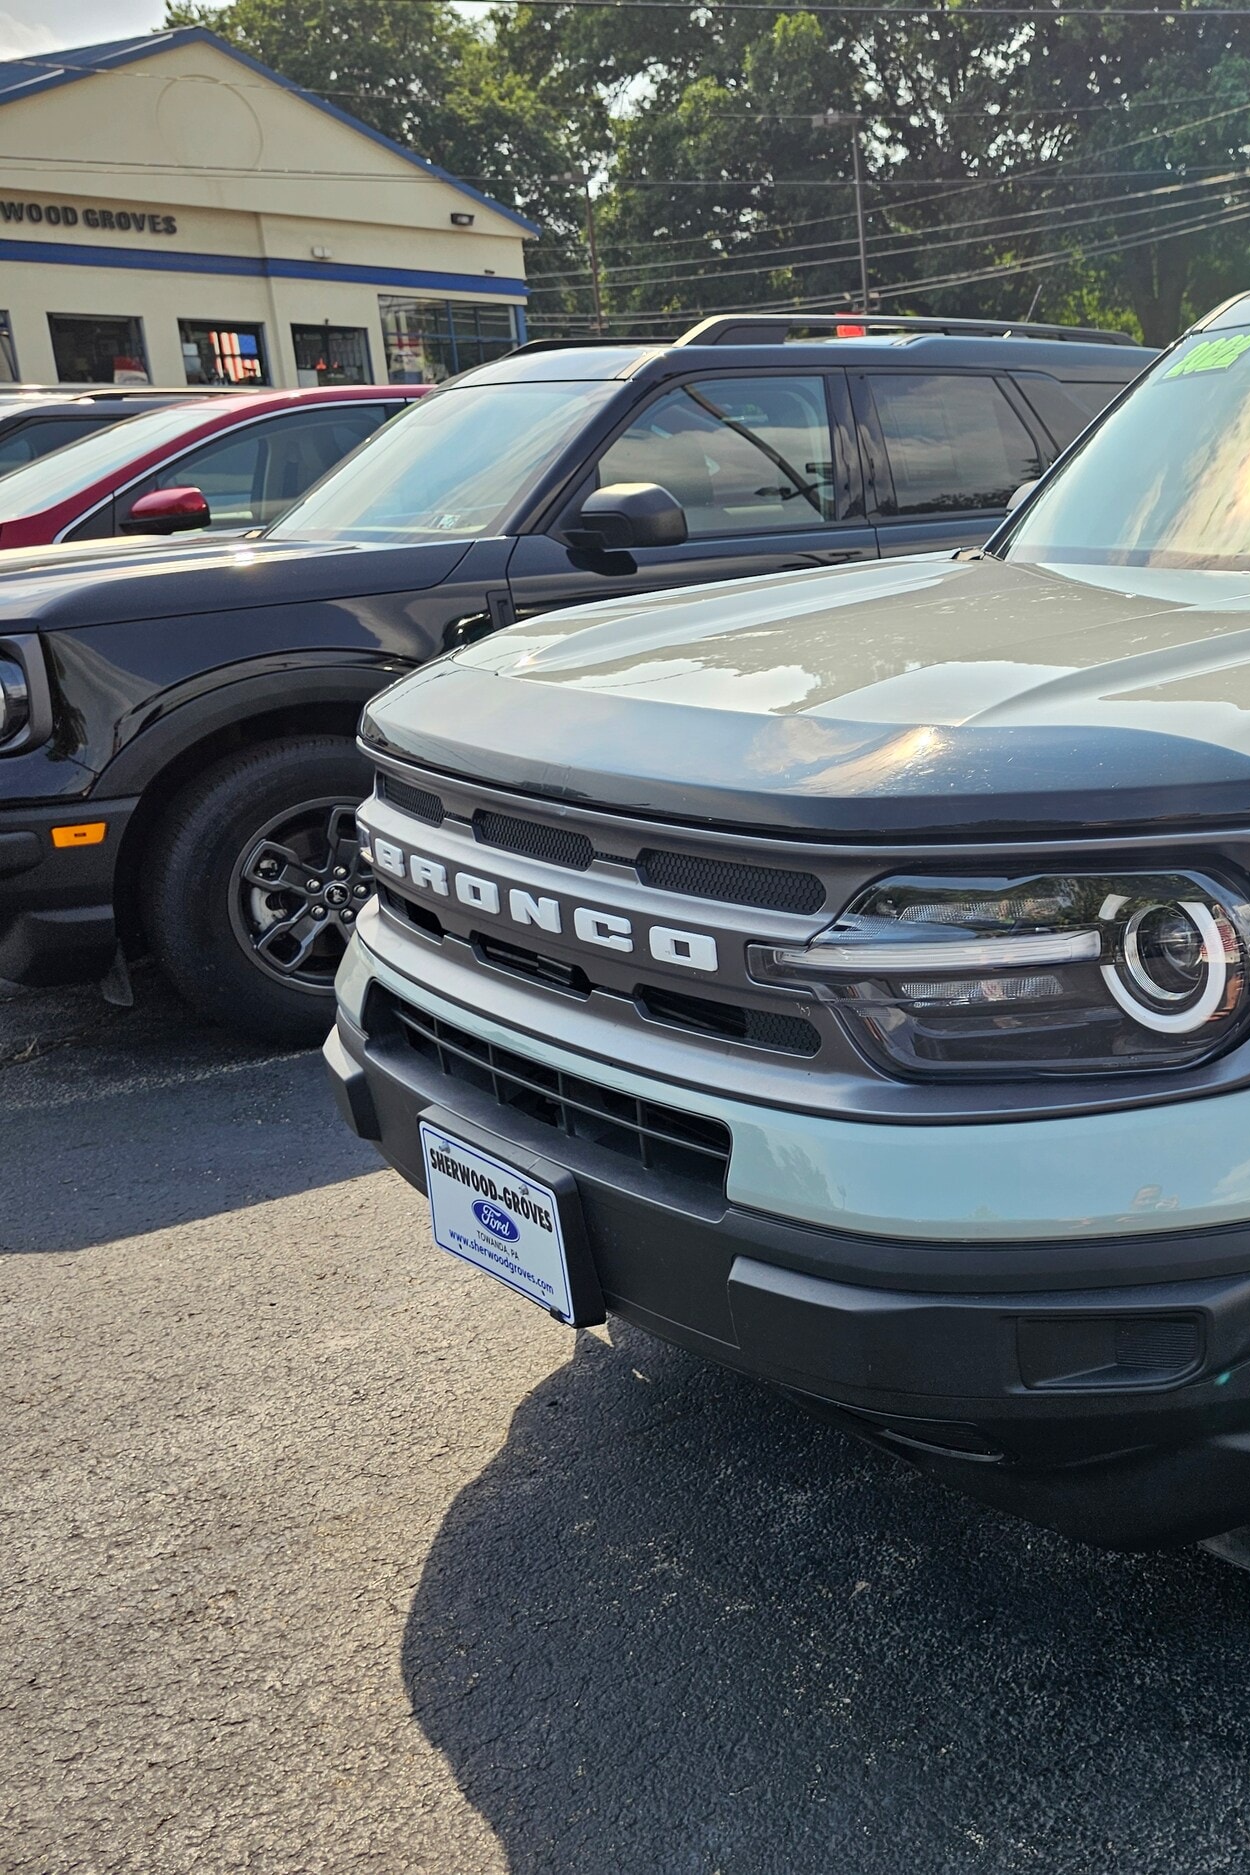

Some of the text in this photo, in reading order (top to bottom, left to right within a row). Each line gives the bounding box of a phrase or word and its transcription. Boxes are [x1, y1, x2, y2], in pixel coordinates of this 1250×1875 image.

[82, 208, 177, 235] GROVES
[374, 837, 720, 972] BRONCO
[429, 1147, 553, 1233] SHERWOOD-GROVES
[481, 1204, 511, 1236] Ford
[448, 1229, 554, 1295] www.sherwoodgroves.com
[510, 1250, 520, 1261] PA
